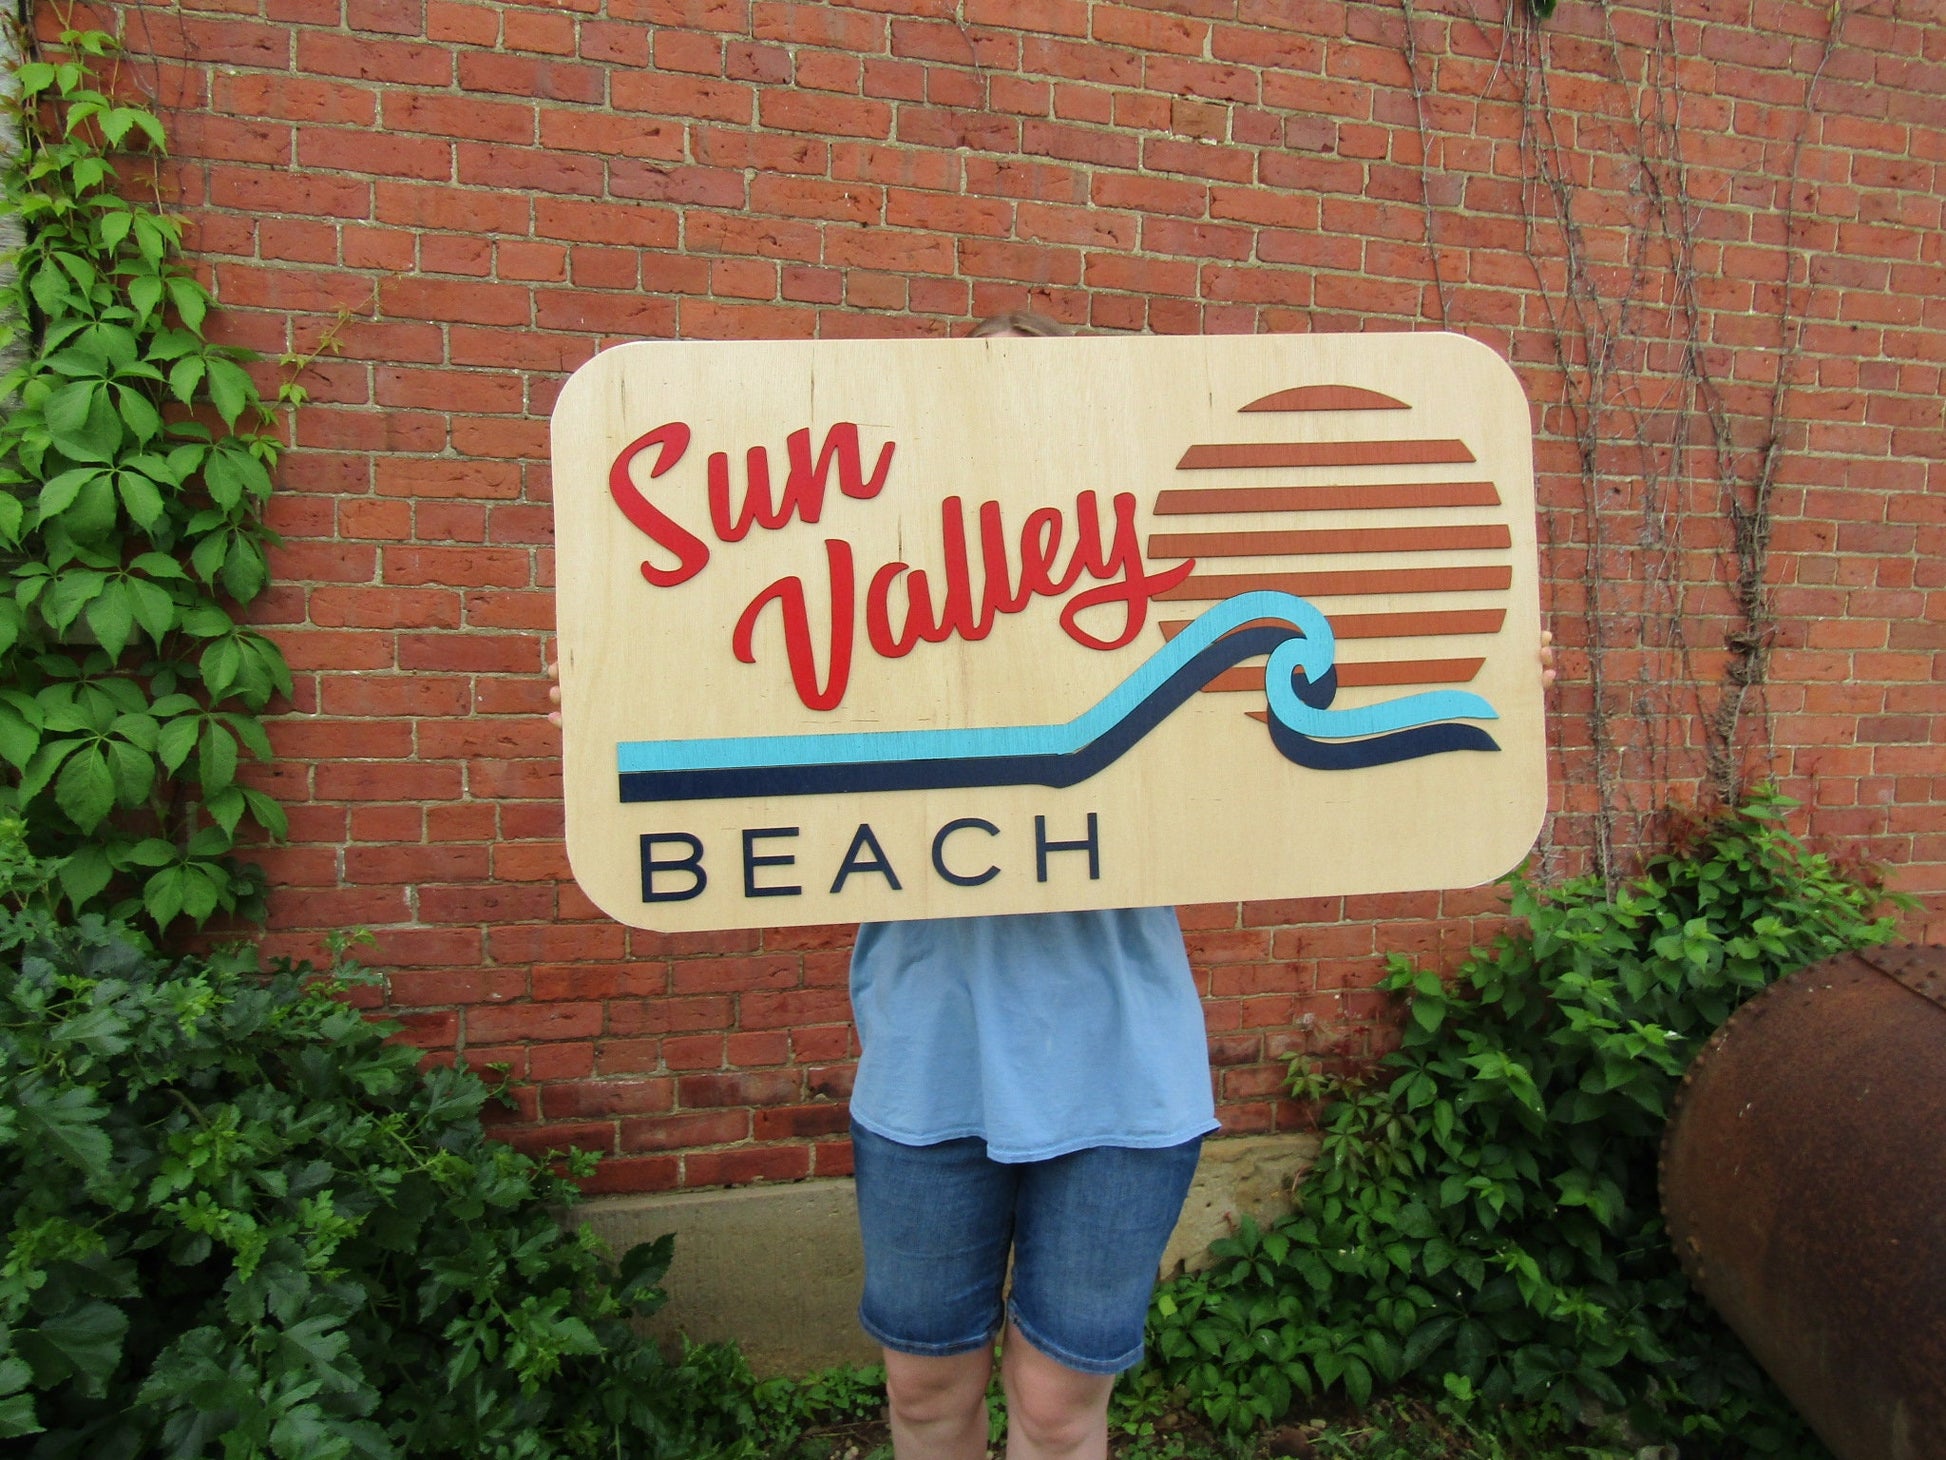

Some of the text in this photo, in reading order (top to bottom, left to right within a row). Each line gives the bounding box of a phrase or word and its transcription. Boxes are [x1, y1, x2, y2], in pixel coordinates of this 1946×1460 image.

[609, 421, 895, 588] Sun
[732, 489, 1195, 712] Valley
[638, 811, 1101, 904] BEACH
